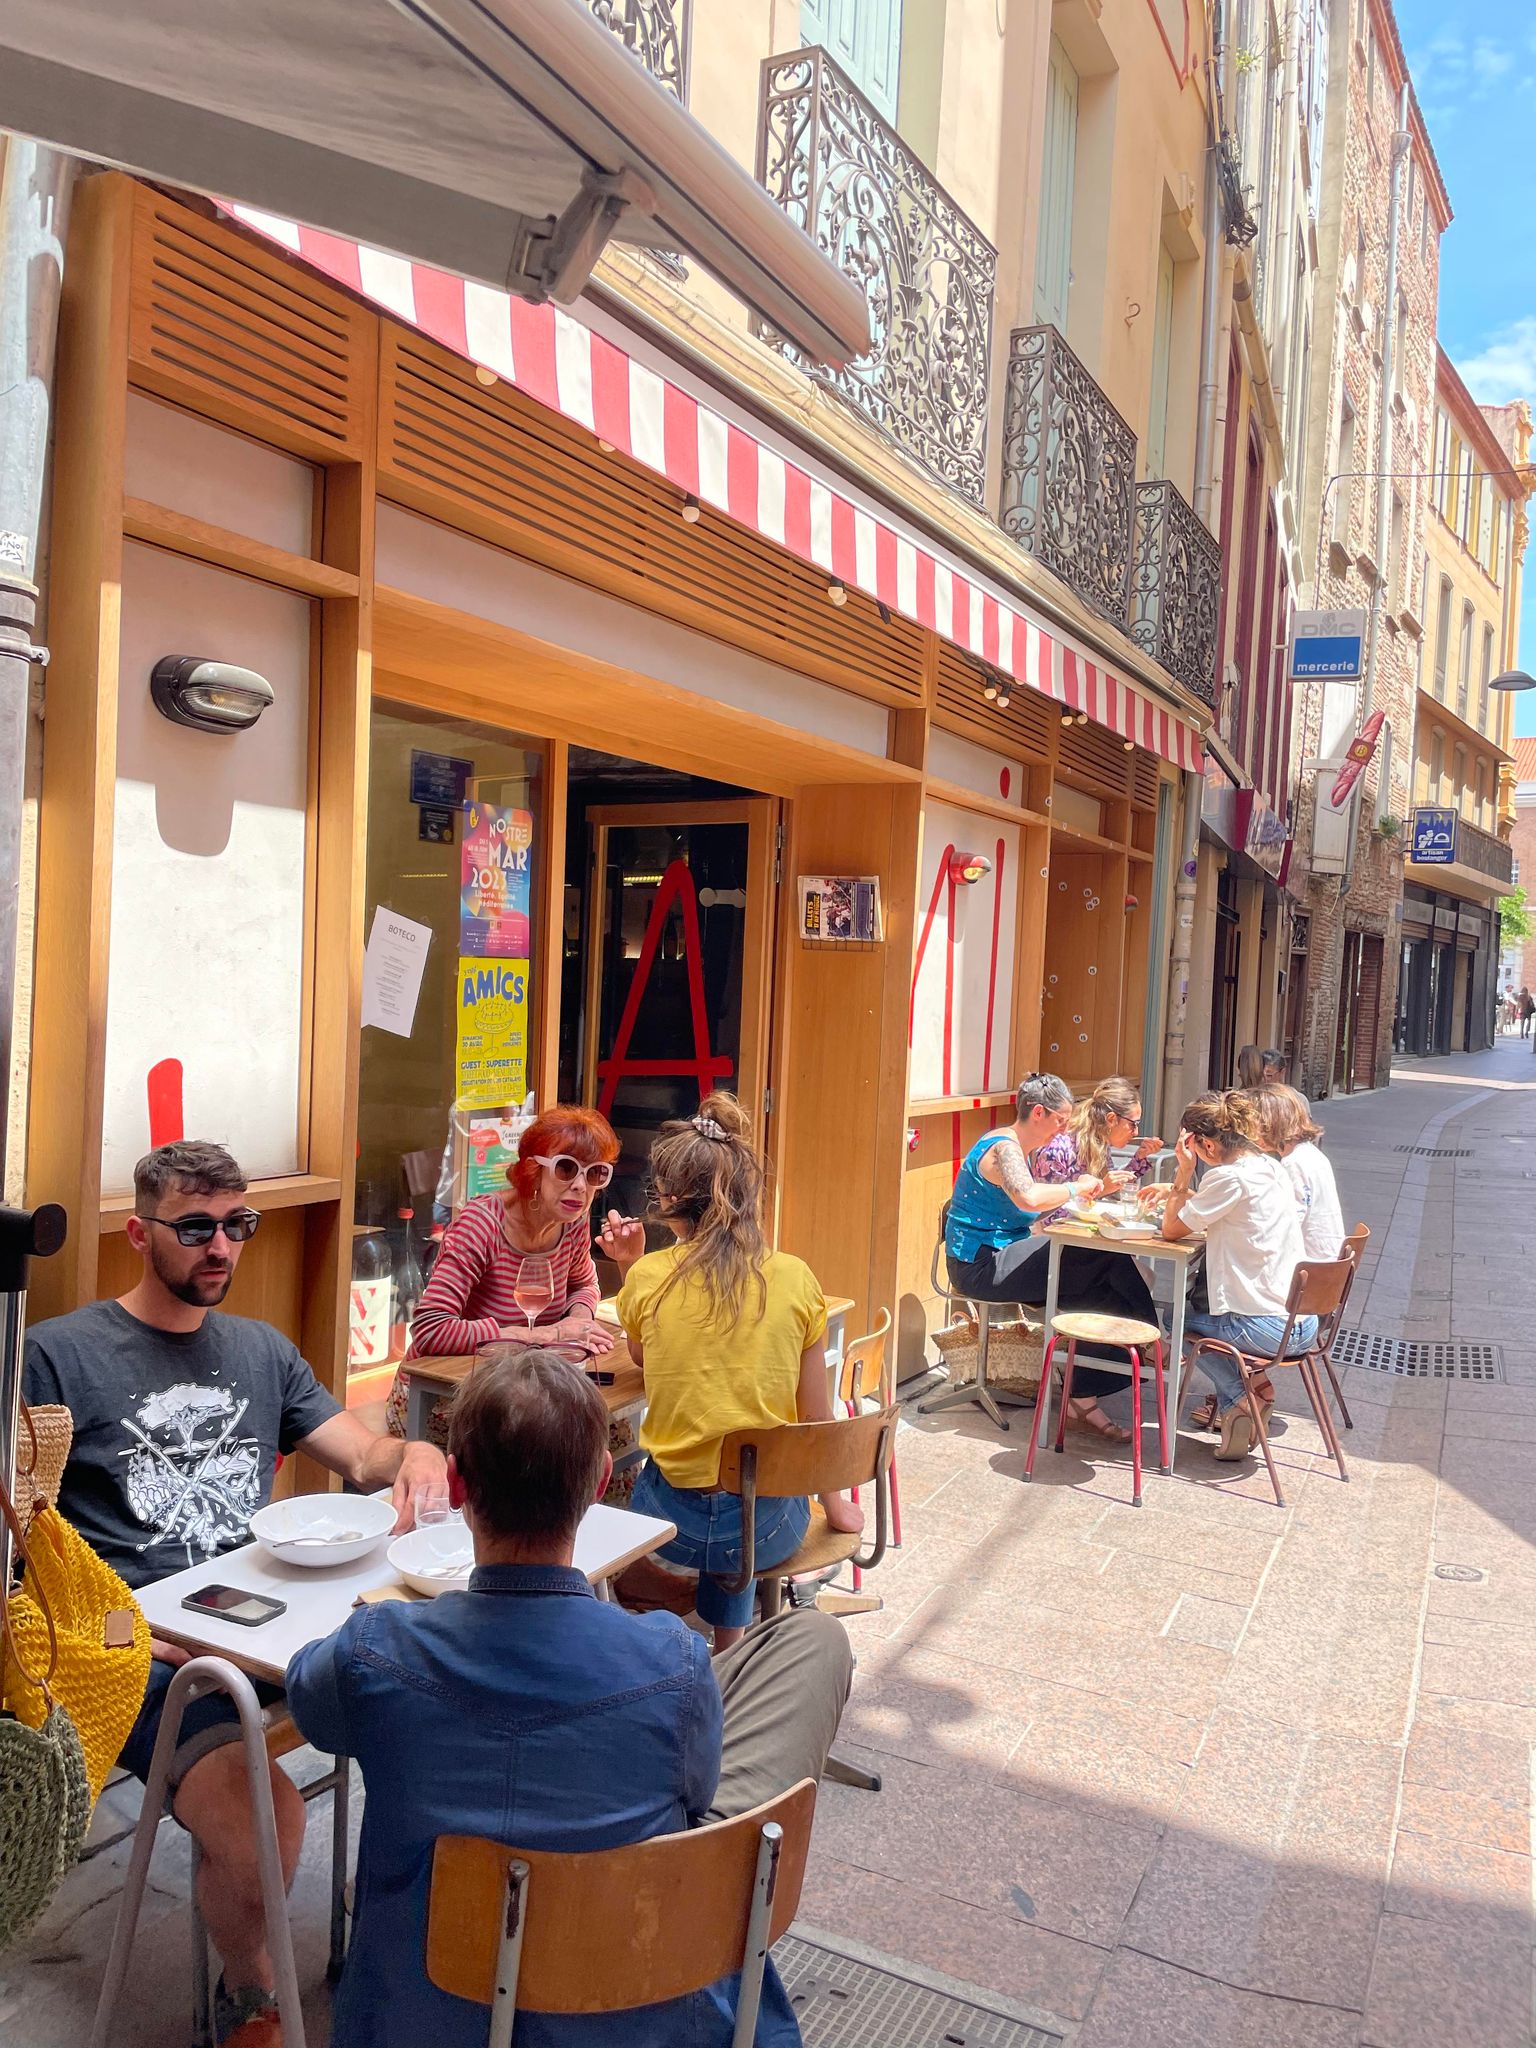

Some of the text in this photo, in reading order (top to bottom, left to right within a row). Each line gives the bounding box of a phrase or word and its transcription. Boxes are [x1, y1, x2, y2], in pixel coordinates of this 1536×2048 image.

[1302, 623, 1356, 635] DMC
[1297, 661, 1355, 672] mercerie
[489, 818, 528, 842] NOSTRE
[489, 842, 528, 871] MAR
[388, 924, 416, 942] BOTECO
[463, 966, 524, 1008] AMICS
[461, 1061, 481, 1069] GUEST
[486, 1059, 522, 1068] SUPERETTE
